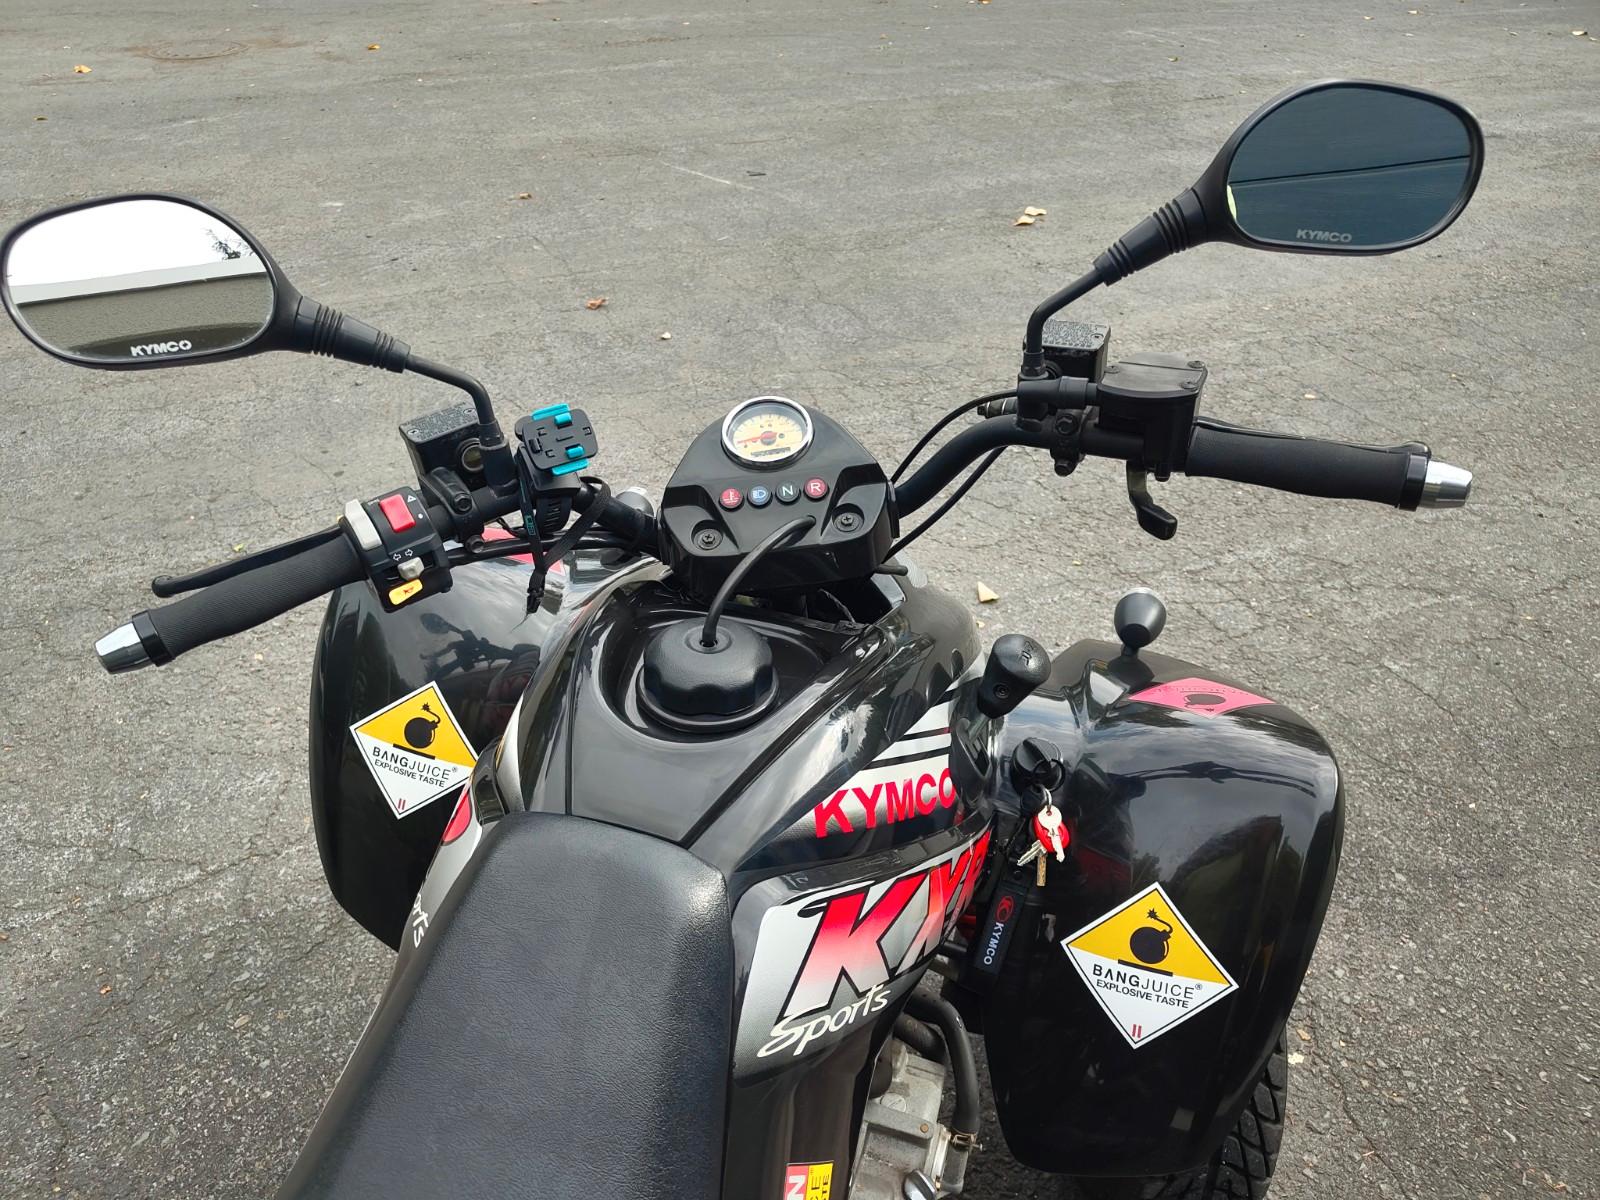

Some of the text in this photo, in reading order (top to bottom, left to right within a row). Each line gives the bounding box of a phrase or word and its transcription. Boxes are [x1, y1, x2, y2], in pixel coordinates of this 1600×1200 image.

[1296, 229, 1352, 243] KYMCO
[130, 340, 192, 357] KYMCO
[781, 485, 794, 496] N
[809, 482, 822, 493] R
[374, 760, 446, 788] EXPLOSIVE TASTE
[813, 767, 956, 839] KYMCO
[412, 892, 429, 948] orts
[983, 921, 1005, 965] KYMCO
[1096, 978, 1190, 1009] EXPLOSIVE TASTE
[757, 983, 891, 1058] Sports
